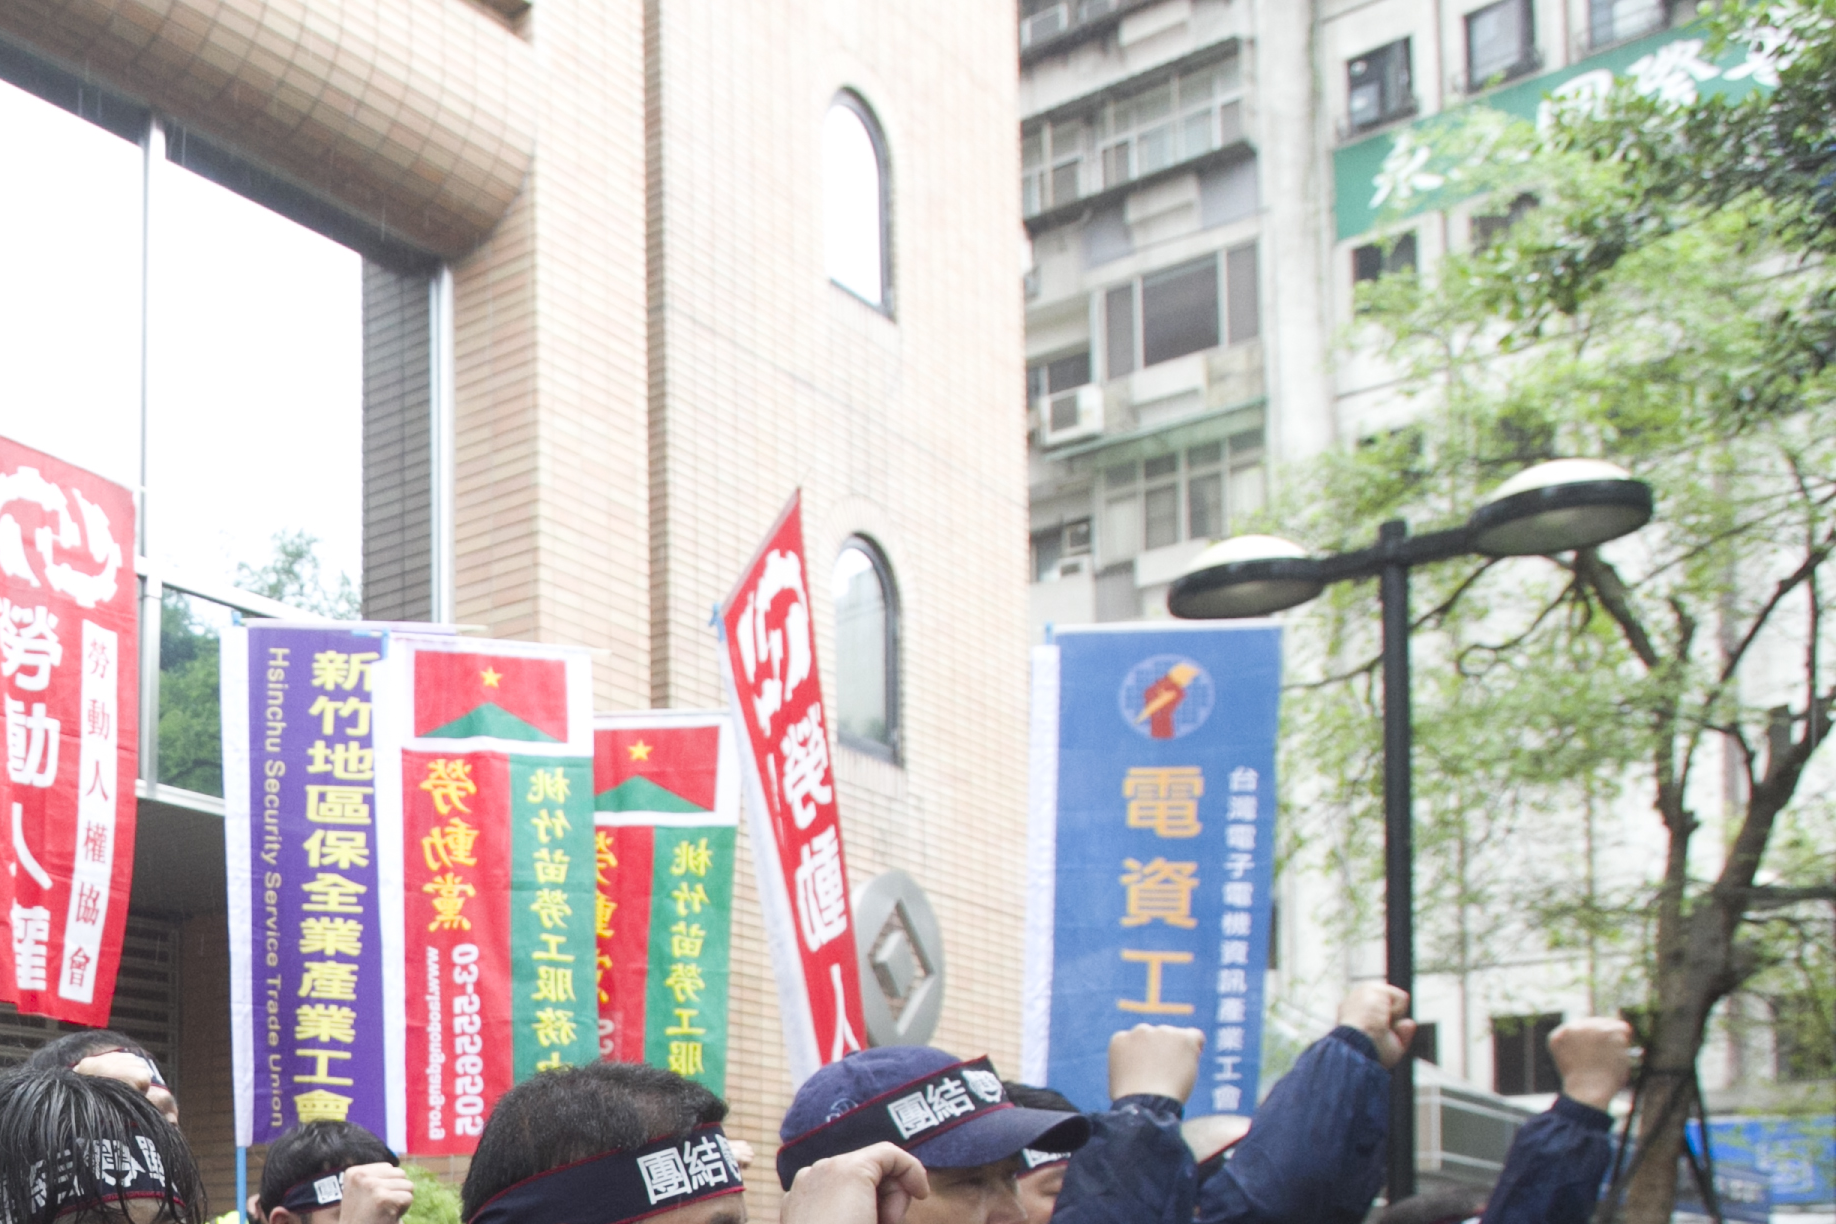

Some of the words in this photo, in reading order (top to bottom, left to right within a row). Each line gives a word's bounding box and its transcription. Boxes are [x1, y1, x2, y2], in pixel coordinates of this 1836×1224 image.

[266, 646, 290, 754] Hsinchu
[68, 639, 111, 988] 勞動人權協會
[260, 759, 286, 867] Security
[265, 872, 282, 968] Service
[1117, 765, 1205, 1016] 電資工
[265, 974, 283, 1048] Trade
[267, 1053, 284, 1129] Union
[887, 1077, 976, 1140] 團結
[636, 1135, 728, 1205] 團結
